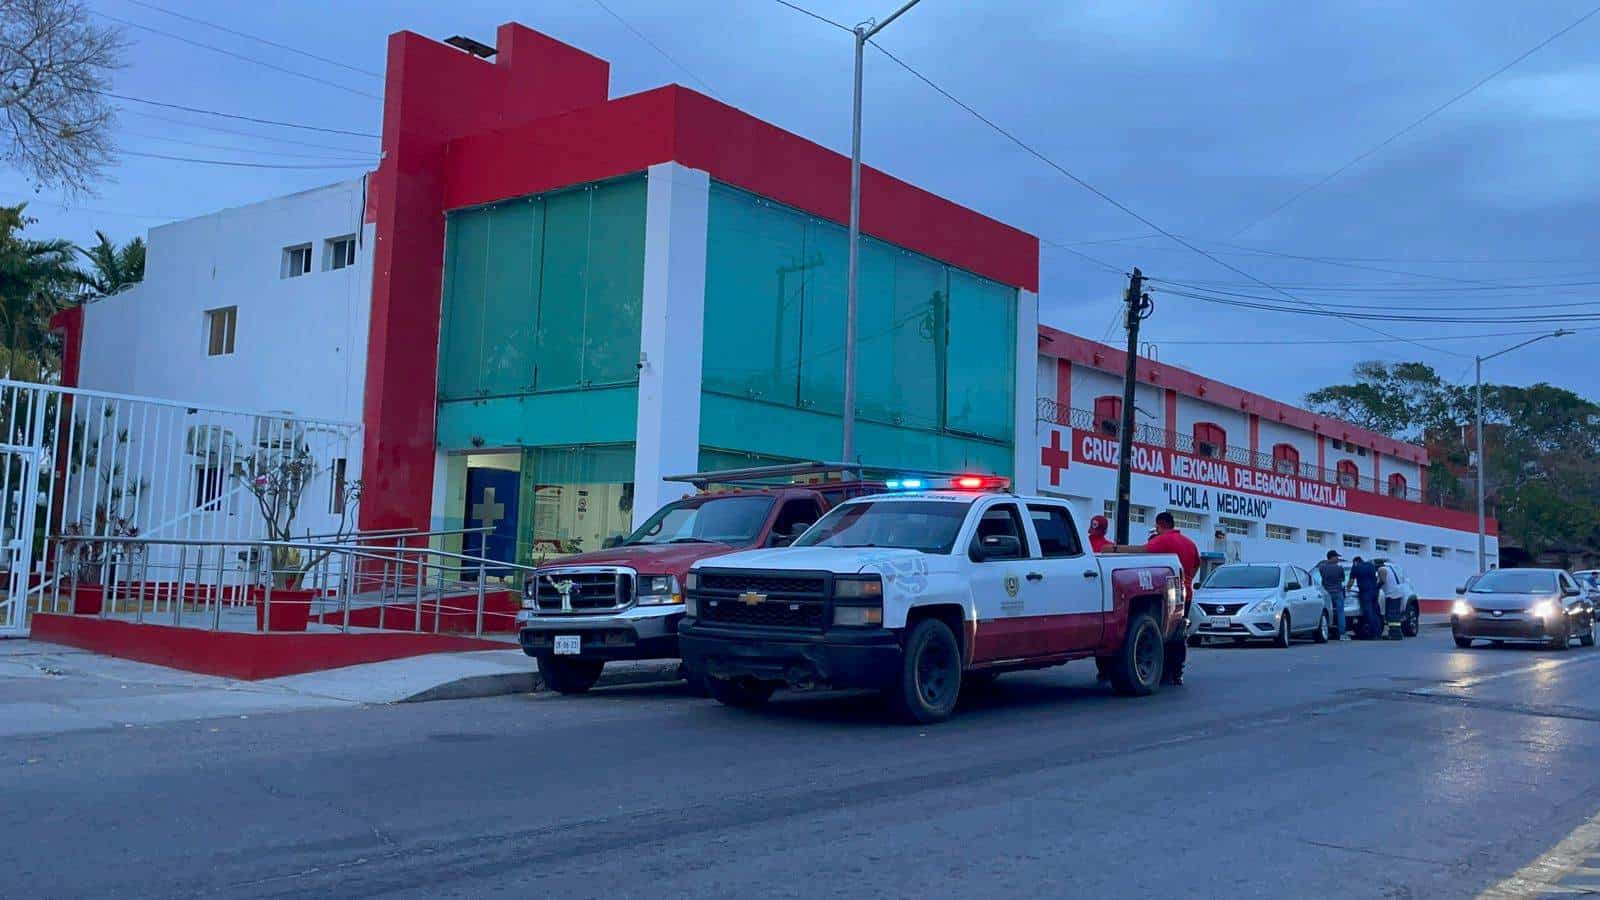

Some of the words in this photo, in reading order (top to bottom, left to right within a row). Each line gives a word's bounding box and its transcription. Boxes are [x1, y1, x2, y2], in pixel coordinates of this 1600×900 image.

[1082, 435, 1121, 465] CRUZ
[1131, 445, 1165, 474] ROJA
[1170, 453, 1231, 487] MEXICANA
[1234, 467, 1297, 499] DELEGACIÓN
[1299, 480, 1347, 508] MAZATLÁN
[1163, 482, 1210, 511] "LUCILA
[1216, 491, 1272, 519] MEDRANO"
